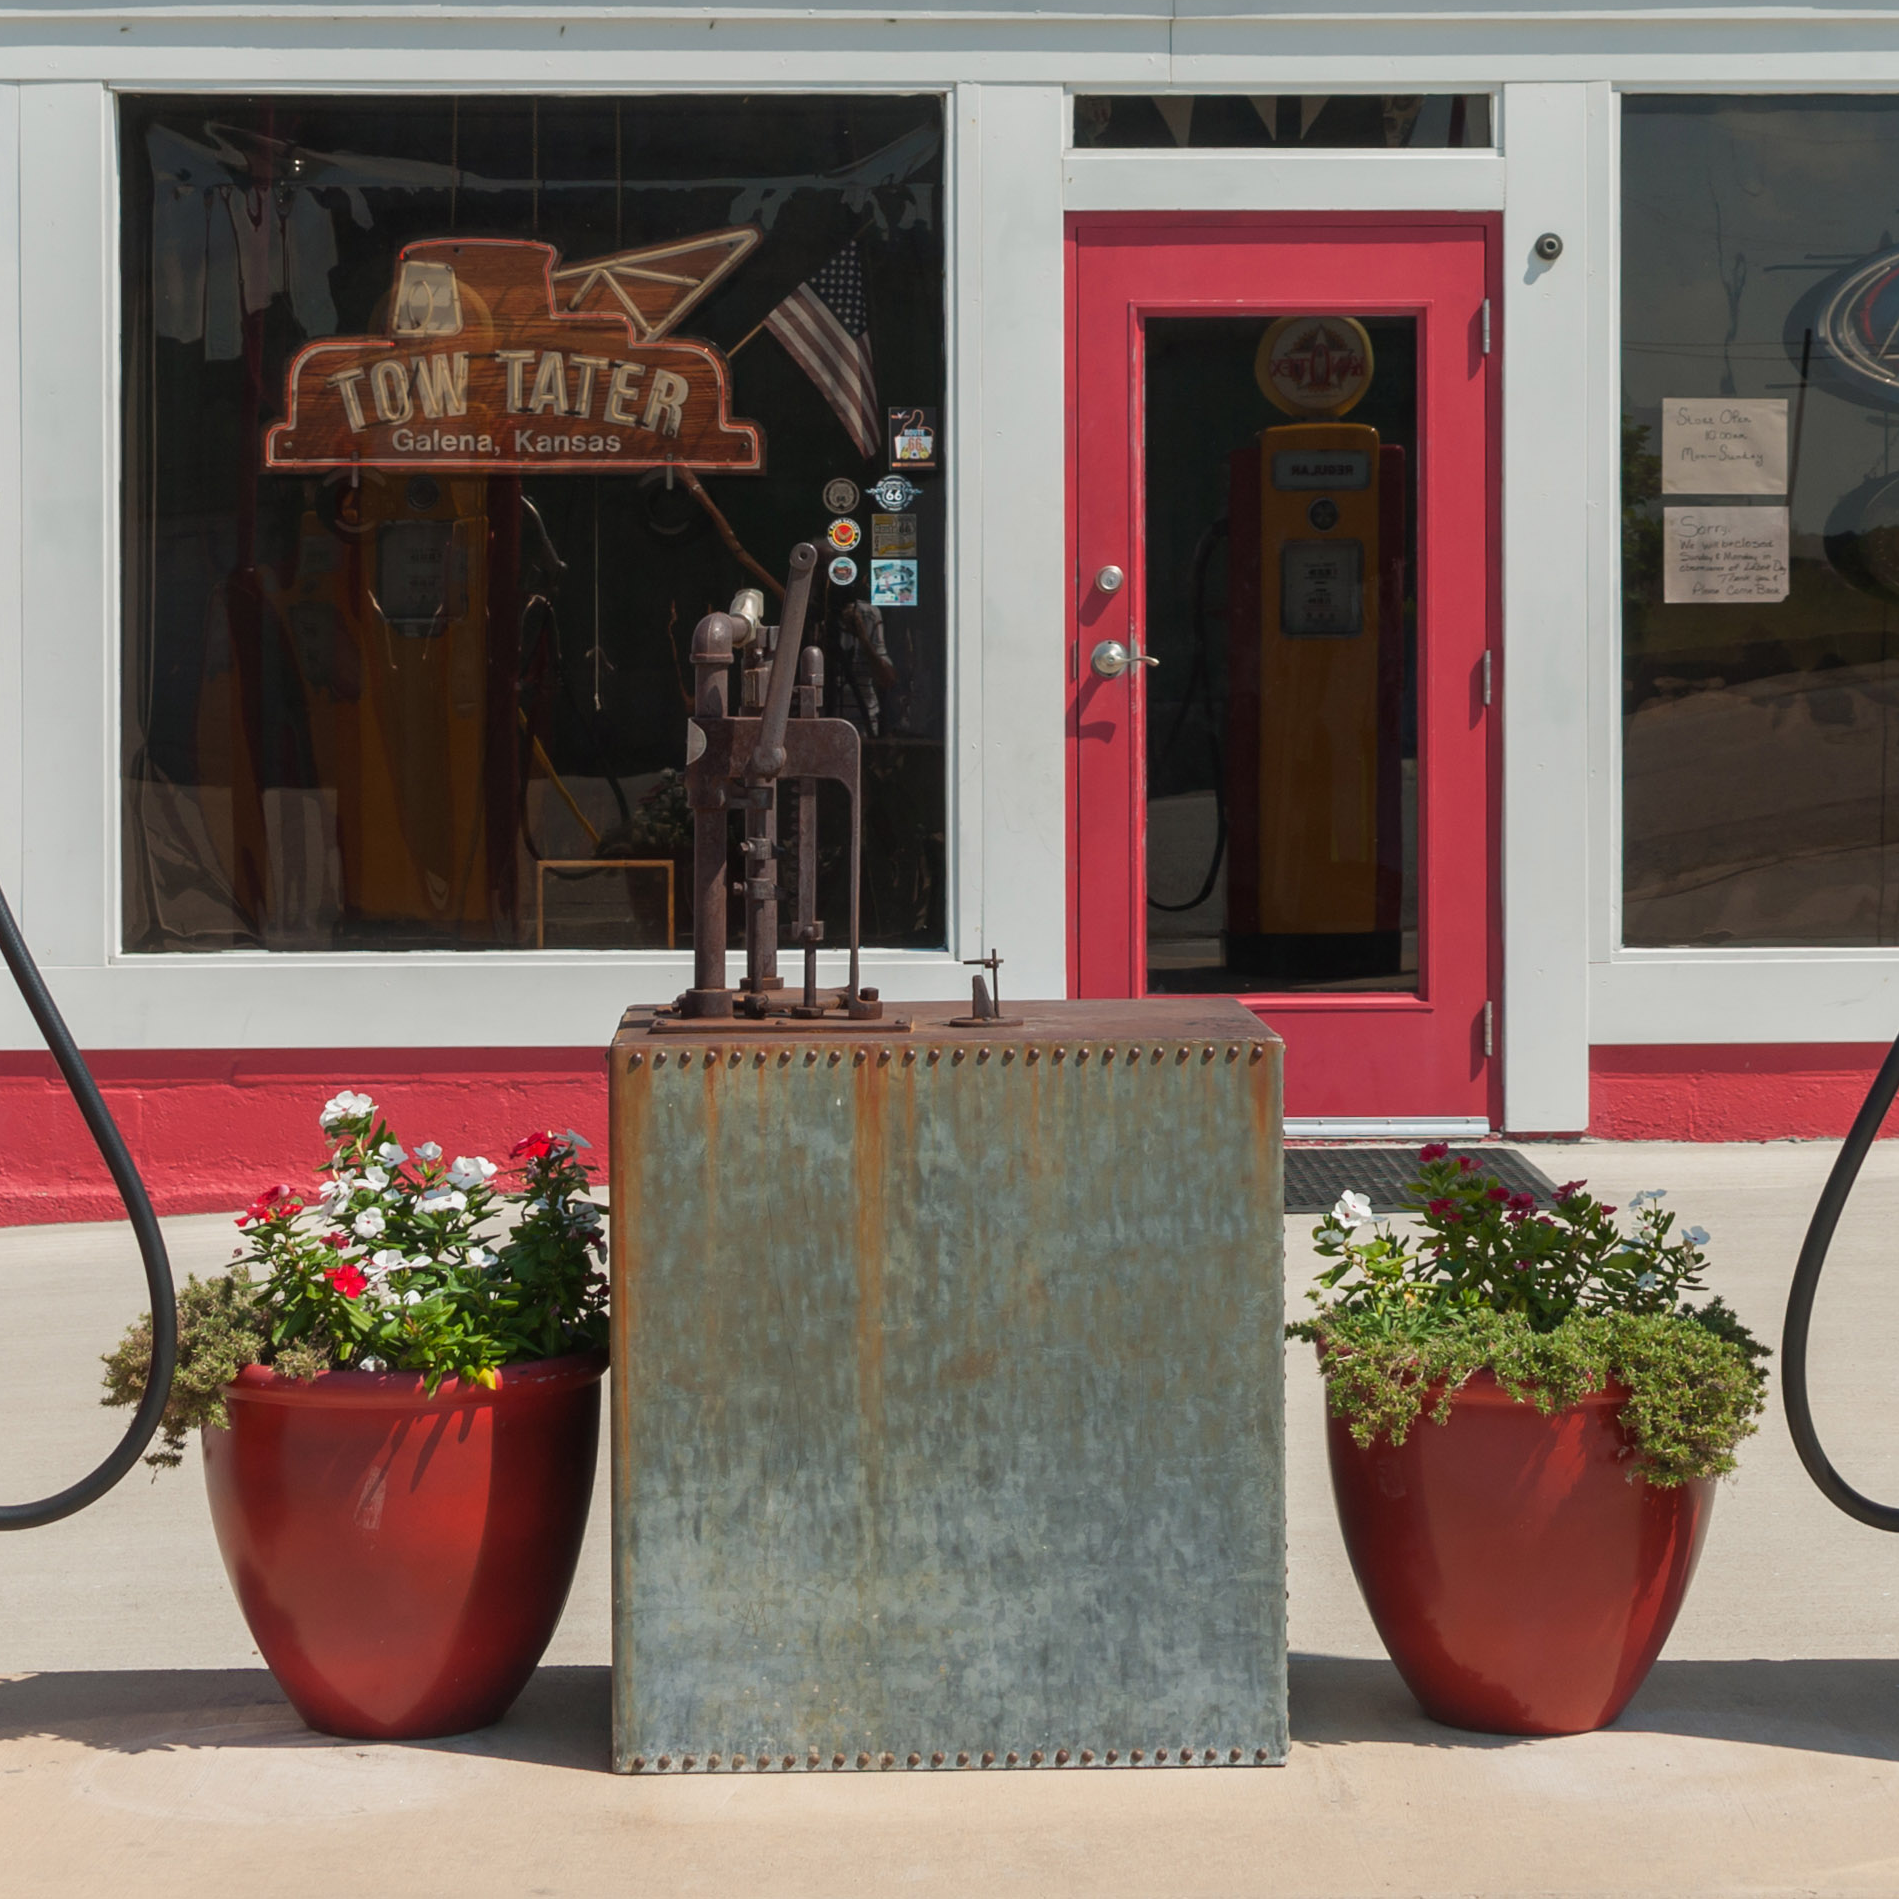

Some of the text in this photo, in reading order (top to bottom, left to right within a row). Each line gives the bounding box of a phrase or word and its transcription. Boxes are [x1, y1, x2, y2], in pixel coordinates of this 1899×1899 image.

[326, 349, 690, 439] TOW TATER
[392, 429, 622, 457] Galena, Kansas
[885, 489, 903, 501] 66
